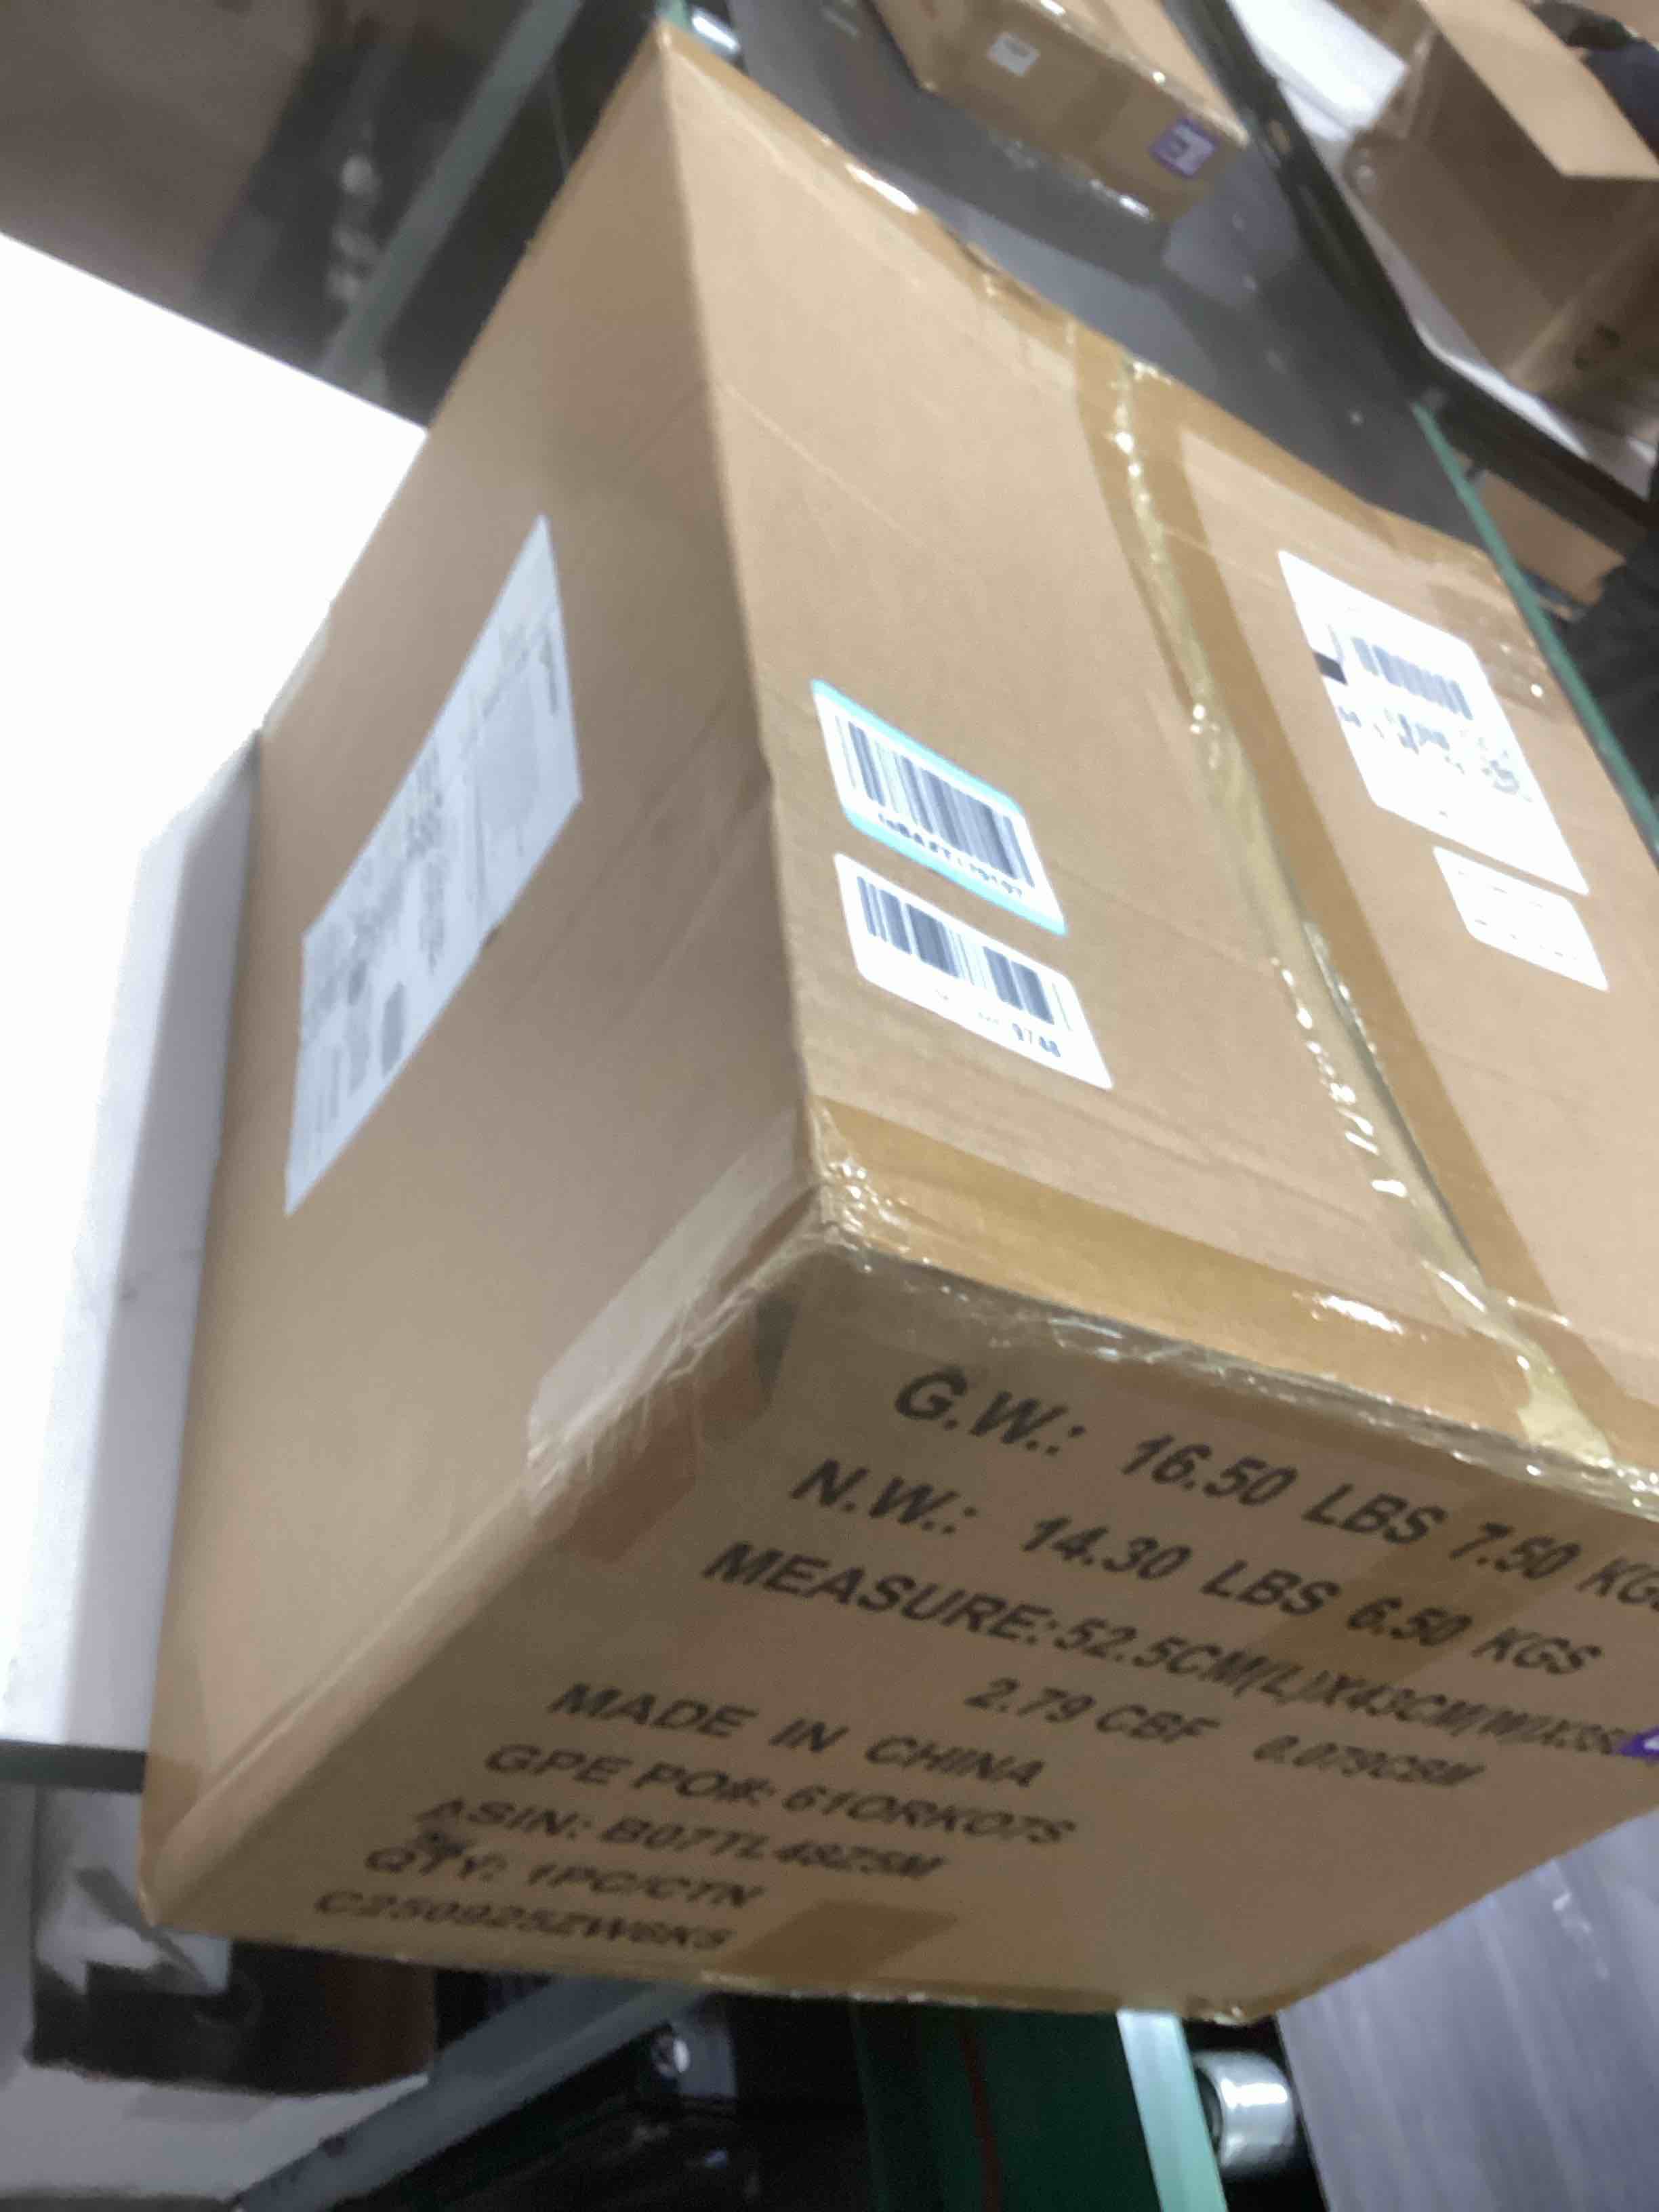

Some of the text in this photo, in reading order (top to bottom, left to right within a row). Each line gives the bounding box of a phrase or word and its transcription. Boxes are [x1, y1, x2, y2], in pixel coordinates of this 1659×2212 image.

[896, 1366, 1659, 1614] G.W.: 16.50 LBS 7.50 KG
[790, 1458, 1603, 1675] N.W.: 14.30 LBS 6.50 KGS
[964, 1678, 1096, 1723] 2.79
[548, 1683, 1044, 1786] MADE IN CHINA
[484, 1744, 633, 1785] GPE
[412, 1797, 592, 1841] ASIN:
[365, 1846, 508, 1881] QTY:
